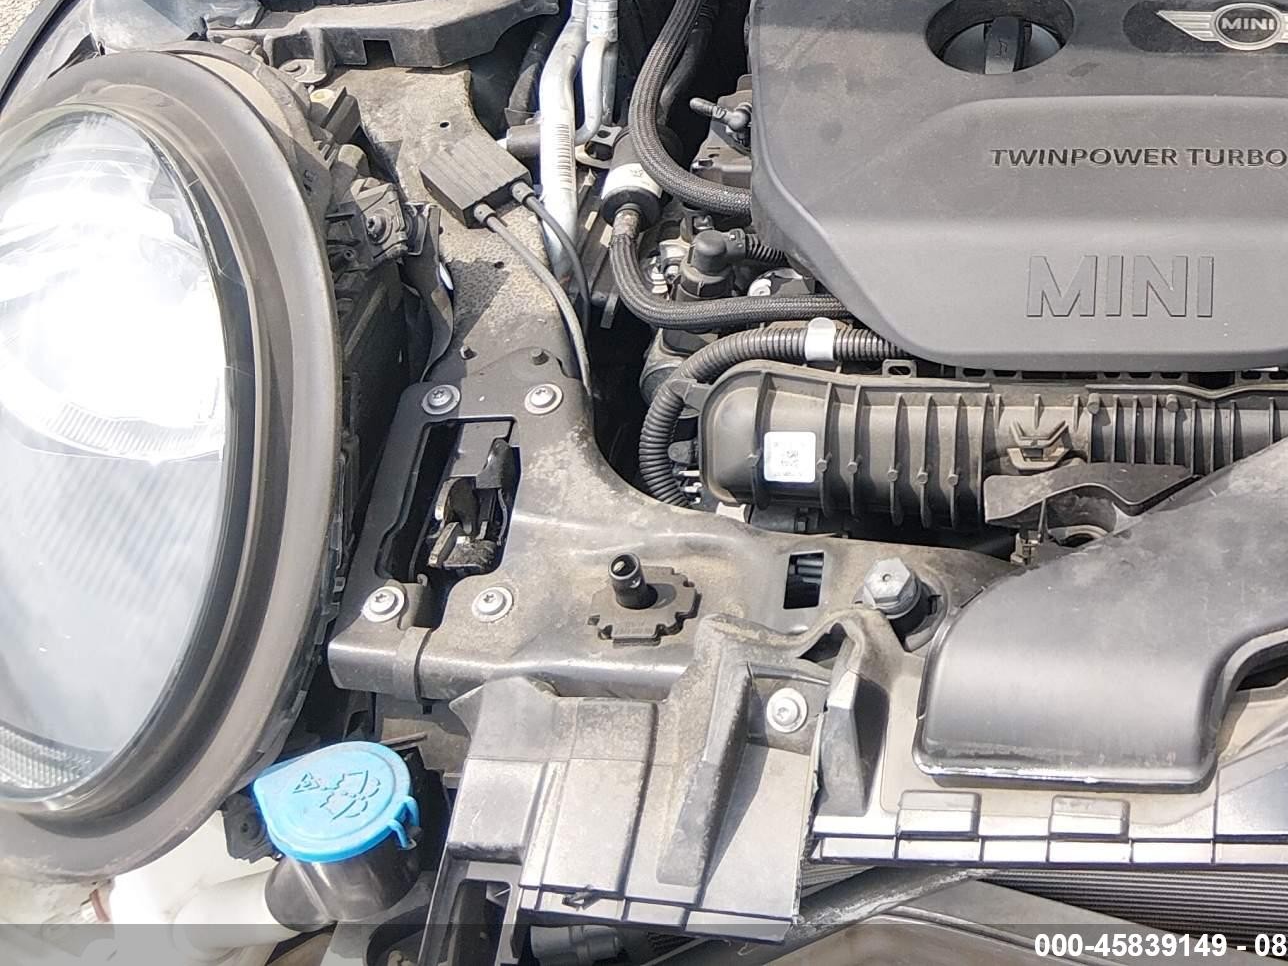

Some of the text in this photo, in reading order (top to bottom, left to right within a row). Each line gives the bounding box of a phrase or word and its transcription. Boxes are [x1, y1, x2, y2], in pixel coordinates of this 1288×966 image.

[1221, 17, 1275, 30] MINI
[991, 148, 1288, 167] TWINPOWER TURBO
[1026, 254, 1215, 318] MINI
